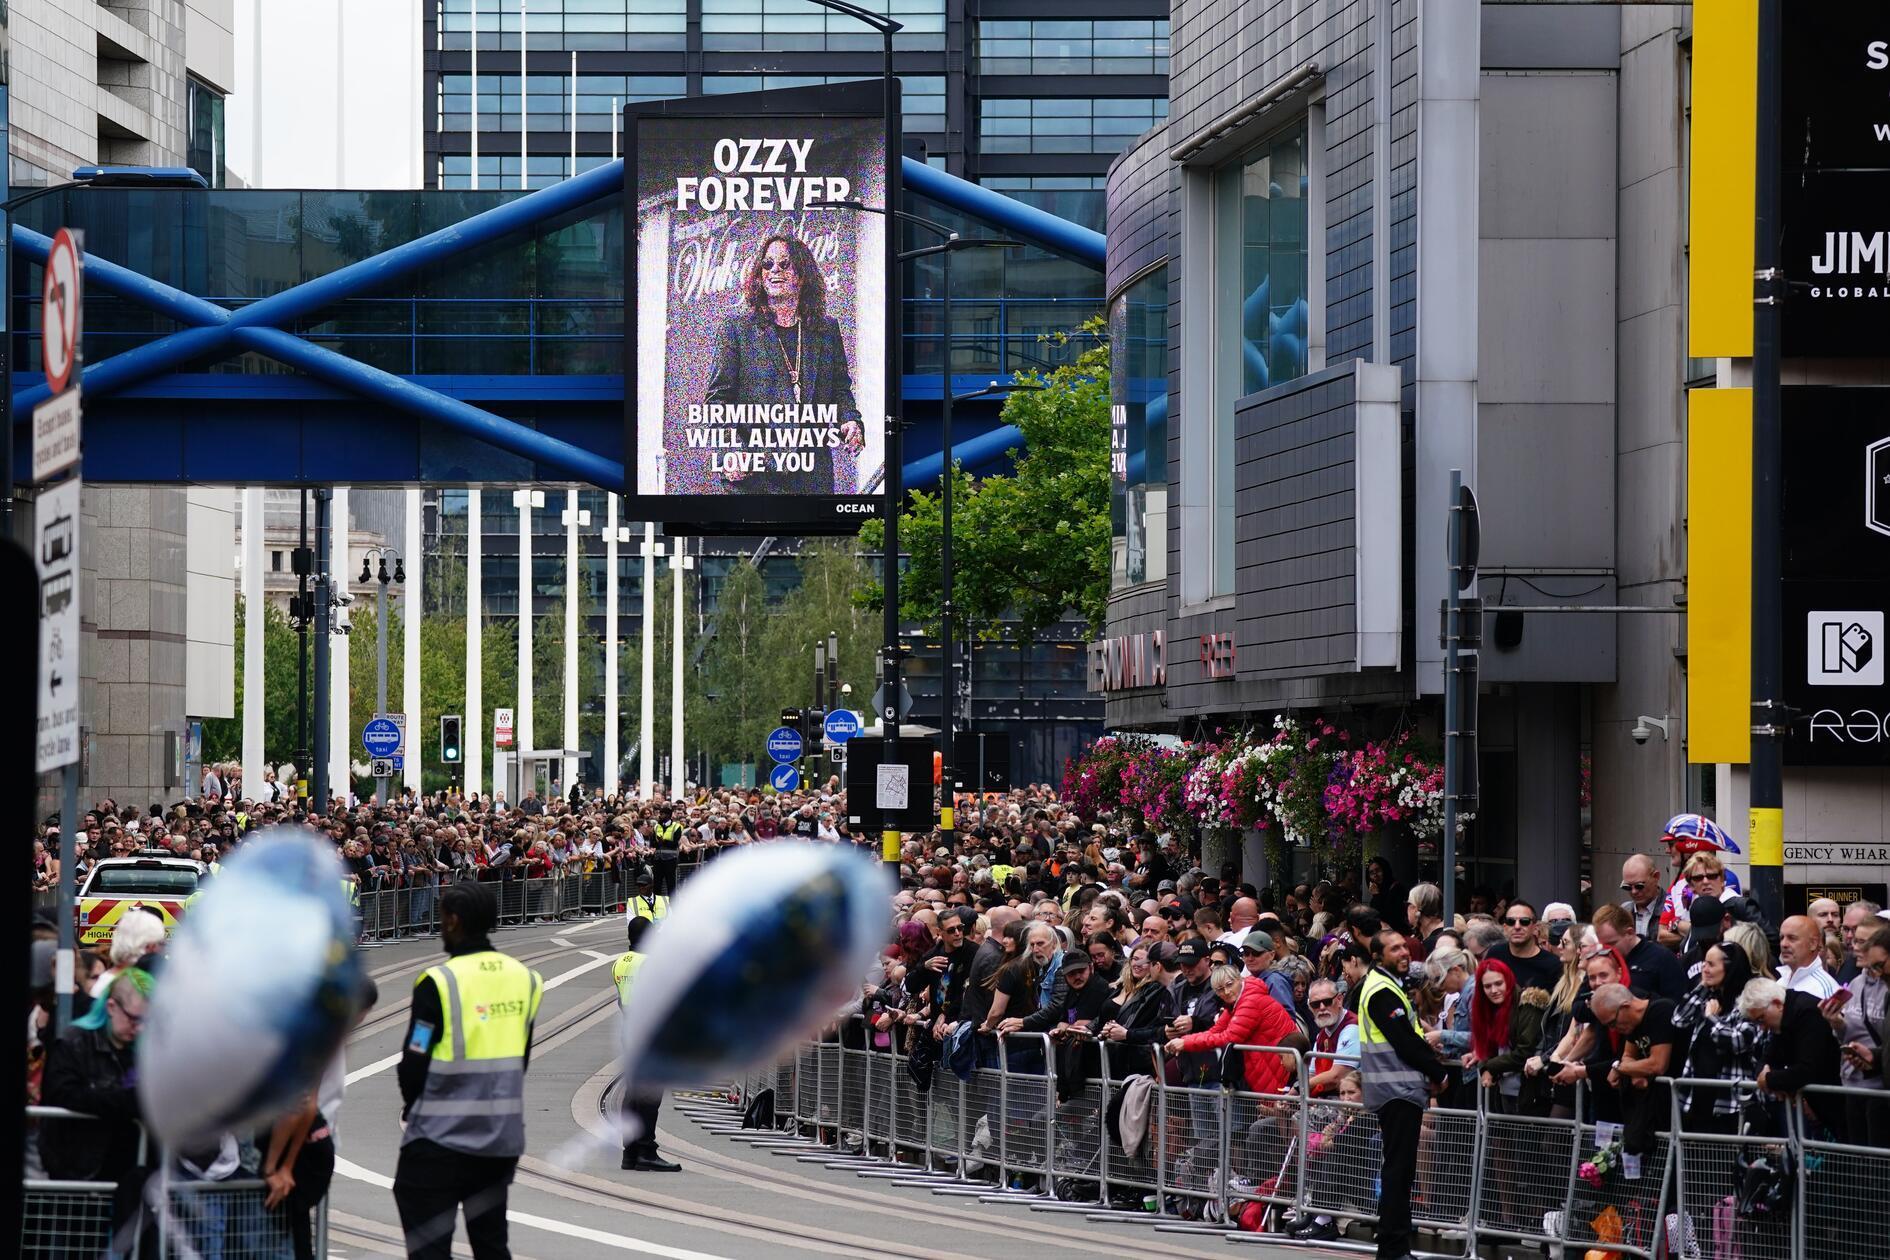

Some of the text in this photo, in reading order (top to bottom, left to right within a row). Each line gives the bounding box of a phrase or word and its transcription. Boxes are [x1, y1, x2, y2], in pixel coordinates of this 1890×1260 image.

[713, 138, 814, 173] OZZY
[677, 177, 849, 211] FOREVER
[1811, 231, 1890, 274] JIM
[1811, 287, 1890, 298] GLOBAL
[688, 403, 838, 424] BIRMINGHAM
[686, 427, 840, 448] WILL ALWAYS
[711, 451, 815, 472] LOVE YOU
[836, 503, 875, 513] OCEAN
[1685, 841, 1698, 849] sky
[1784, 847, 1889, 860] GENCY WHAR
